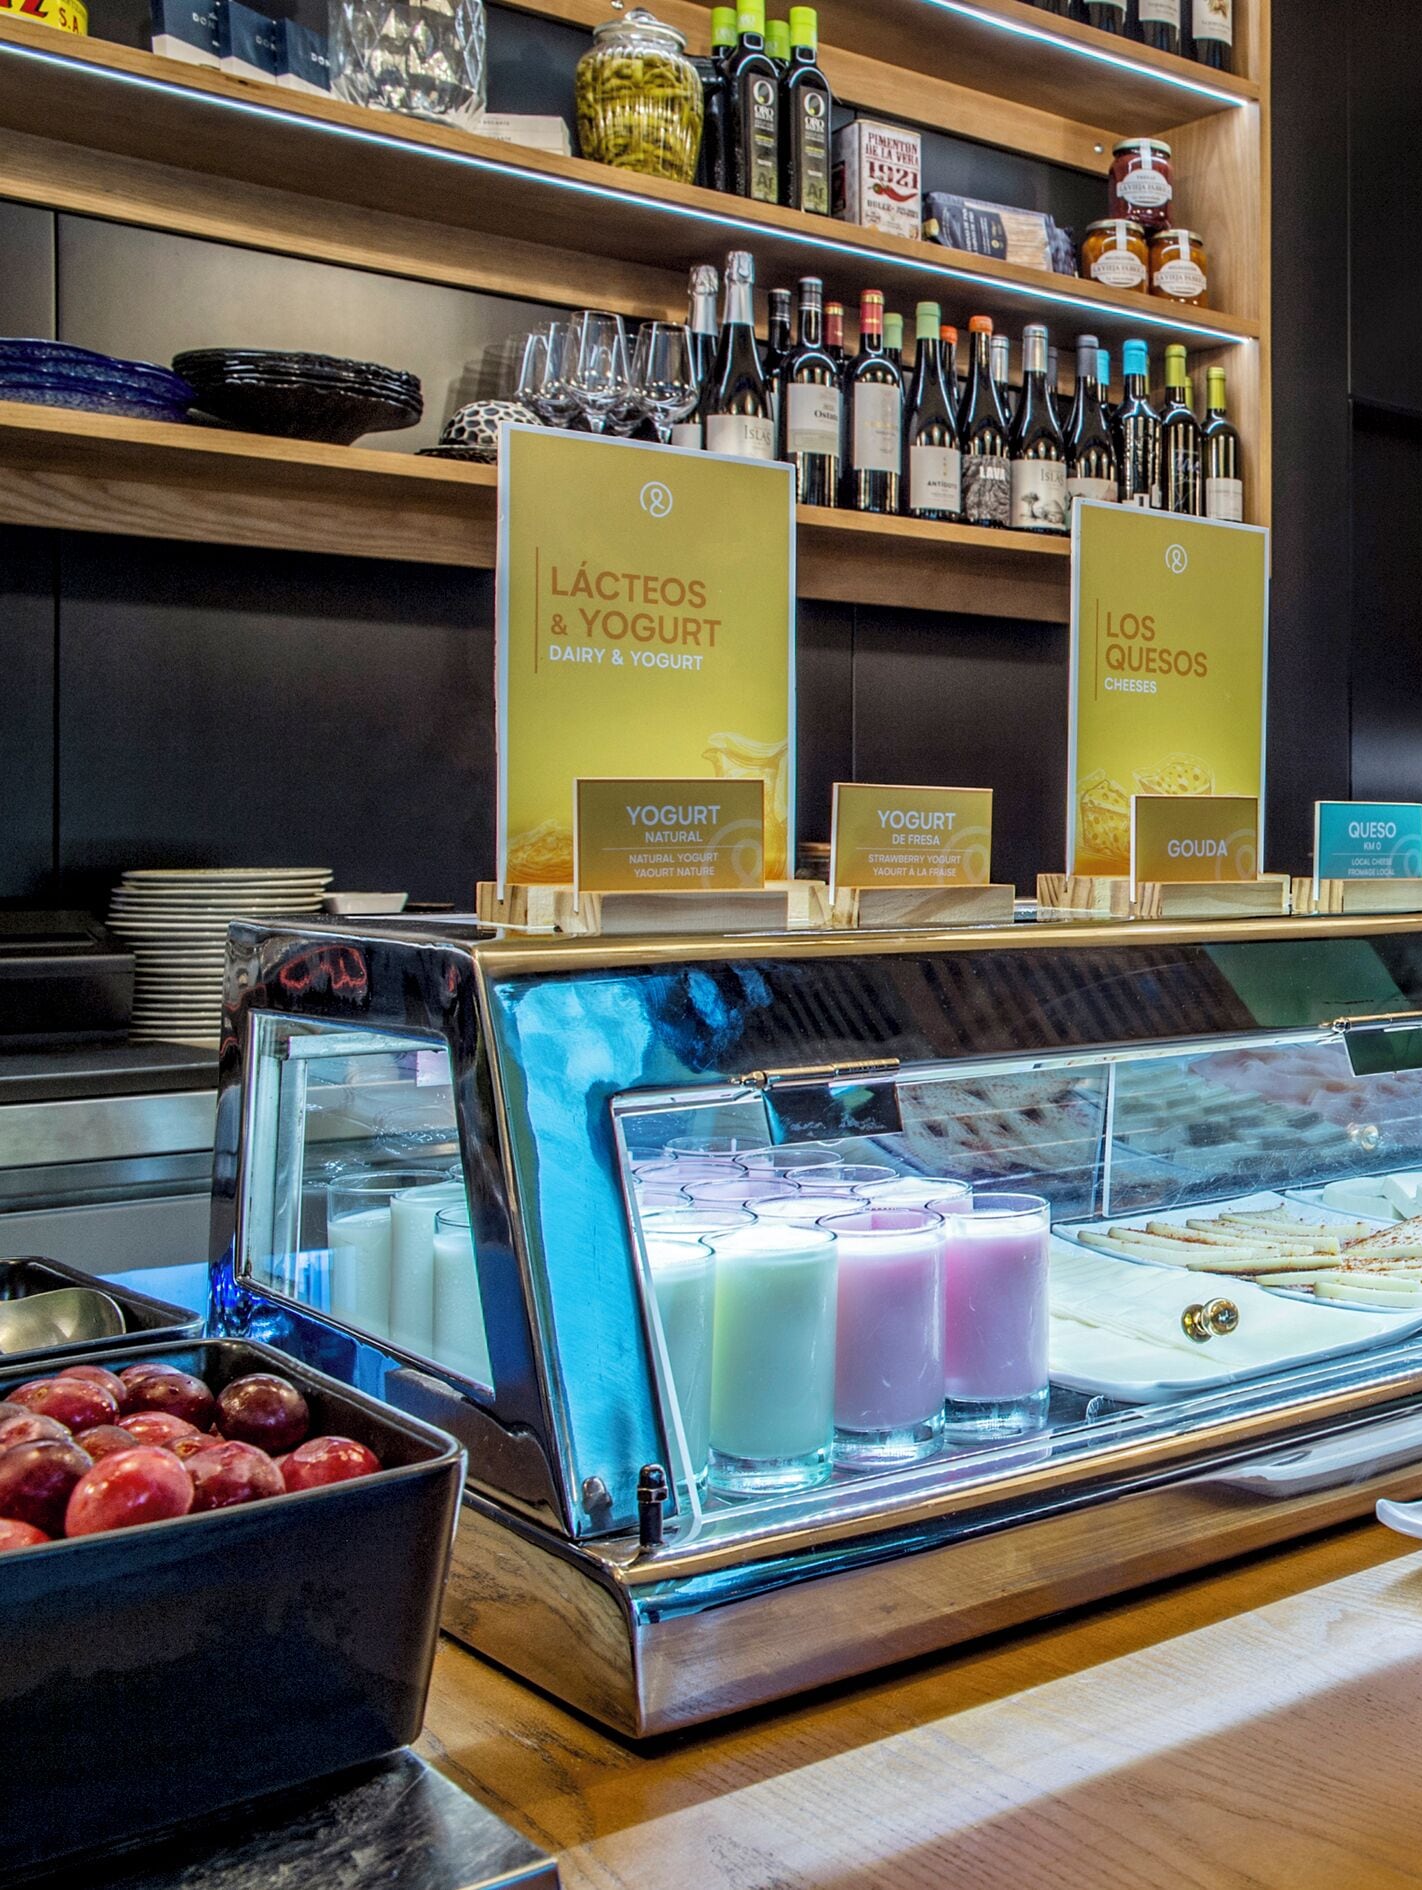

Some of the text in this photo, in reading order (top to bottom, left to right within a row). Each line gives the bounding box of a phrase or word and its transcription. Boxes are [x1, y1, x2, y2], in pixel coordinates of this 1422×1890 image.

[865, 143, 879, 156] DE
[881, 147, 893, 161] LA
[866, 160, 919, 190] 1921
[979, 465, 1006, 481] LAVA
[551, 560, 707, 609] LÁCTEOS
[551, 608, 722, 648] & YOGURT
[1106, 611, 1155, 642] LOS
[549, 645, 703, 671] DAIRY & YOGURT
[1105, 643, 1208, 678] QUESOS
[1104, 676, 1157, 694] CHEESES
[626, 805, 721, 826] YOGURT
[877, 809, 956, 831] YOGURT
[645, 831, 703, 844] NATURAL
[1348, 821, 1397, 839] QUESO
[892, 834, 940, 846] DE FRESA
[1167, 839, 1228, 858] GOUDA
[629, 852, 718, 865] NATURAL YOGURT
[868, 854, 961, 865] STRAWBERRY YOGURT
[634, 866, 716, 878] YAOURT NATURE
[873, 867, 907, 877] YAOURT
[917, 867, 927, 876] LA
[929, 867, 957, 877] FRAISE
